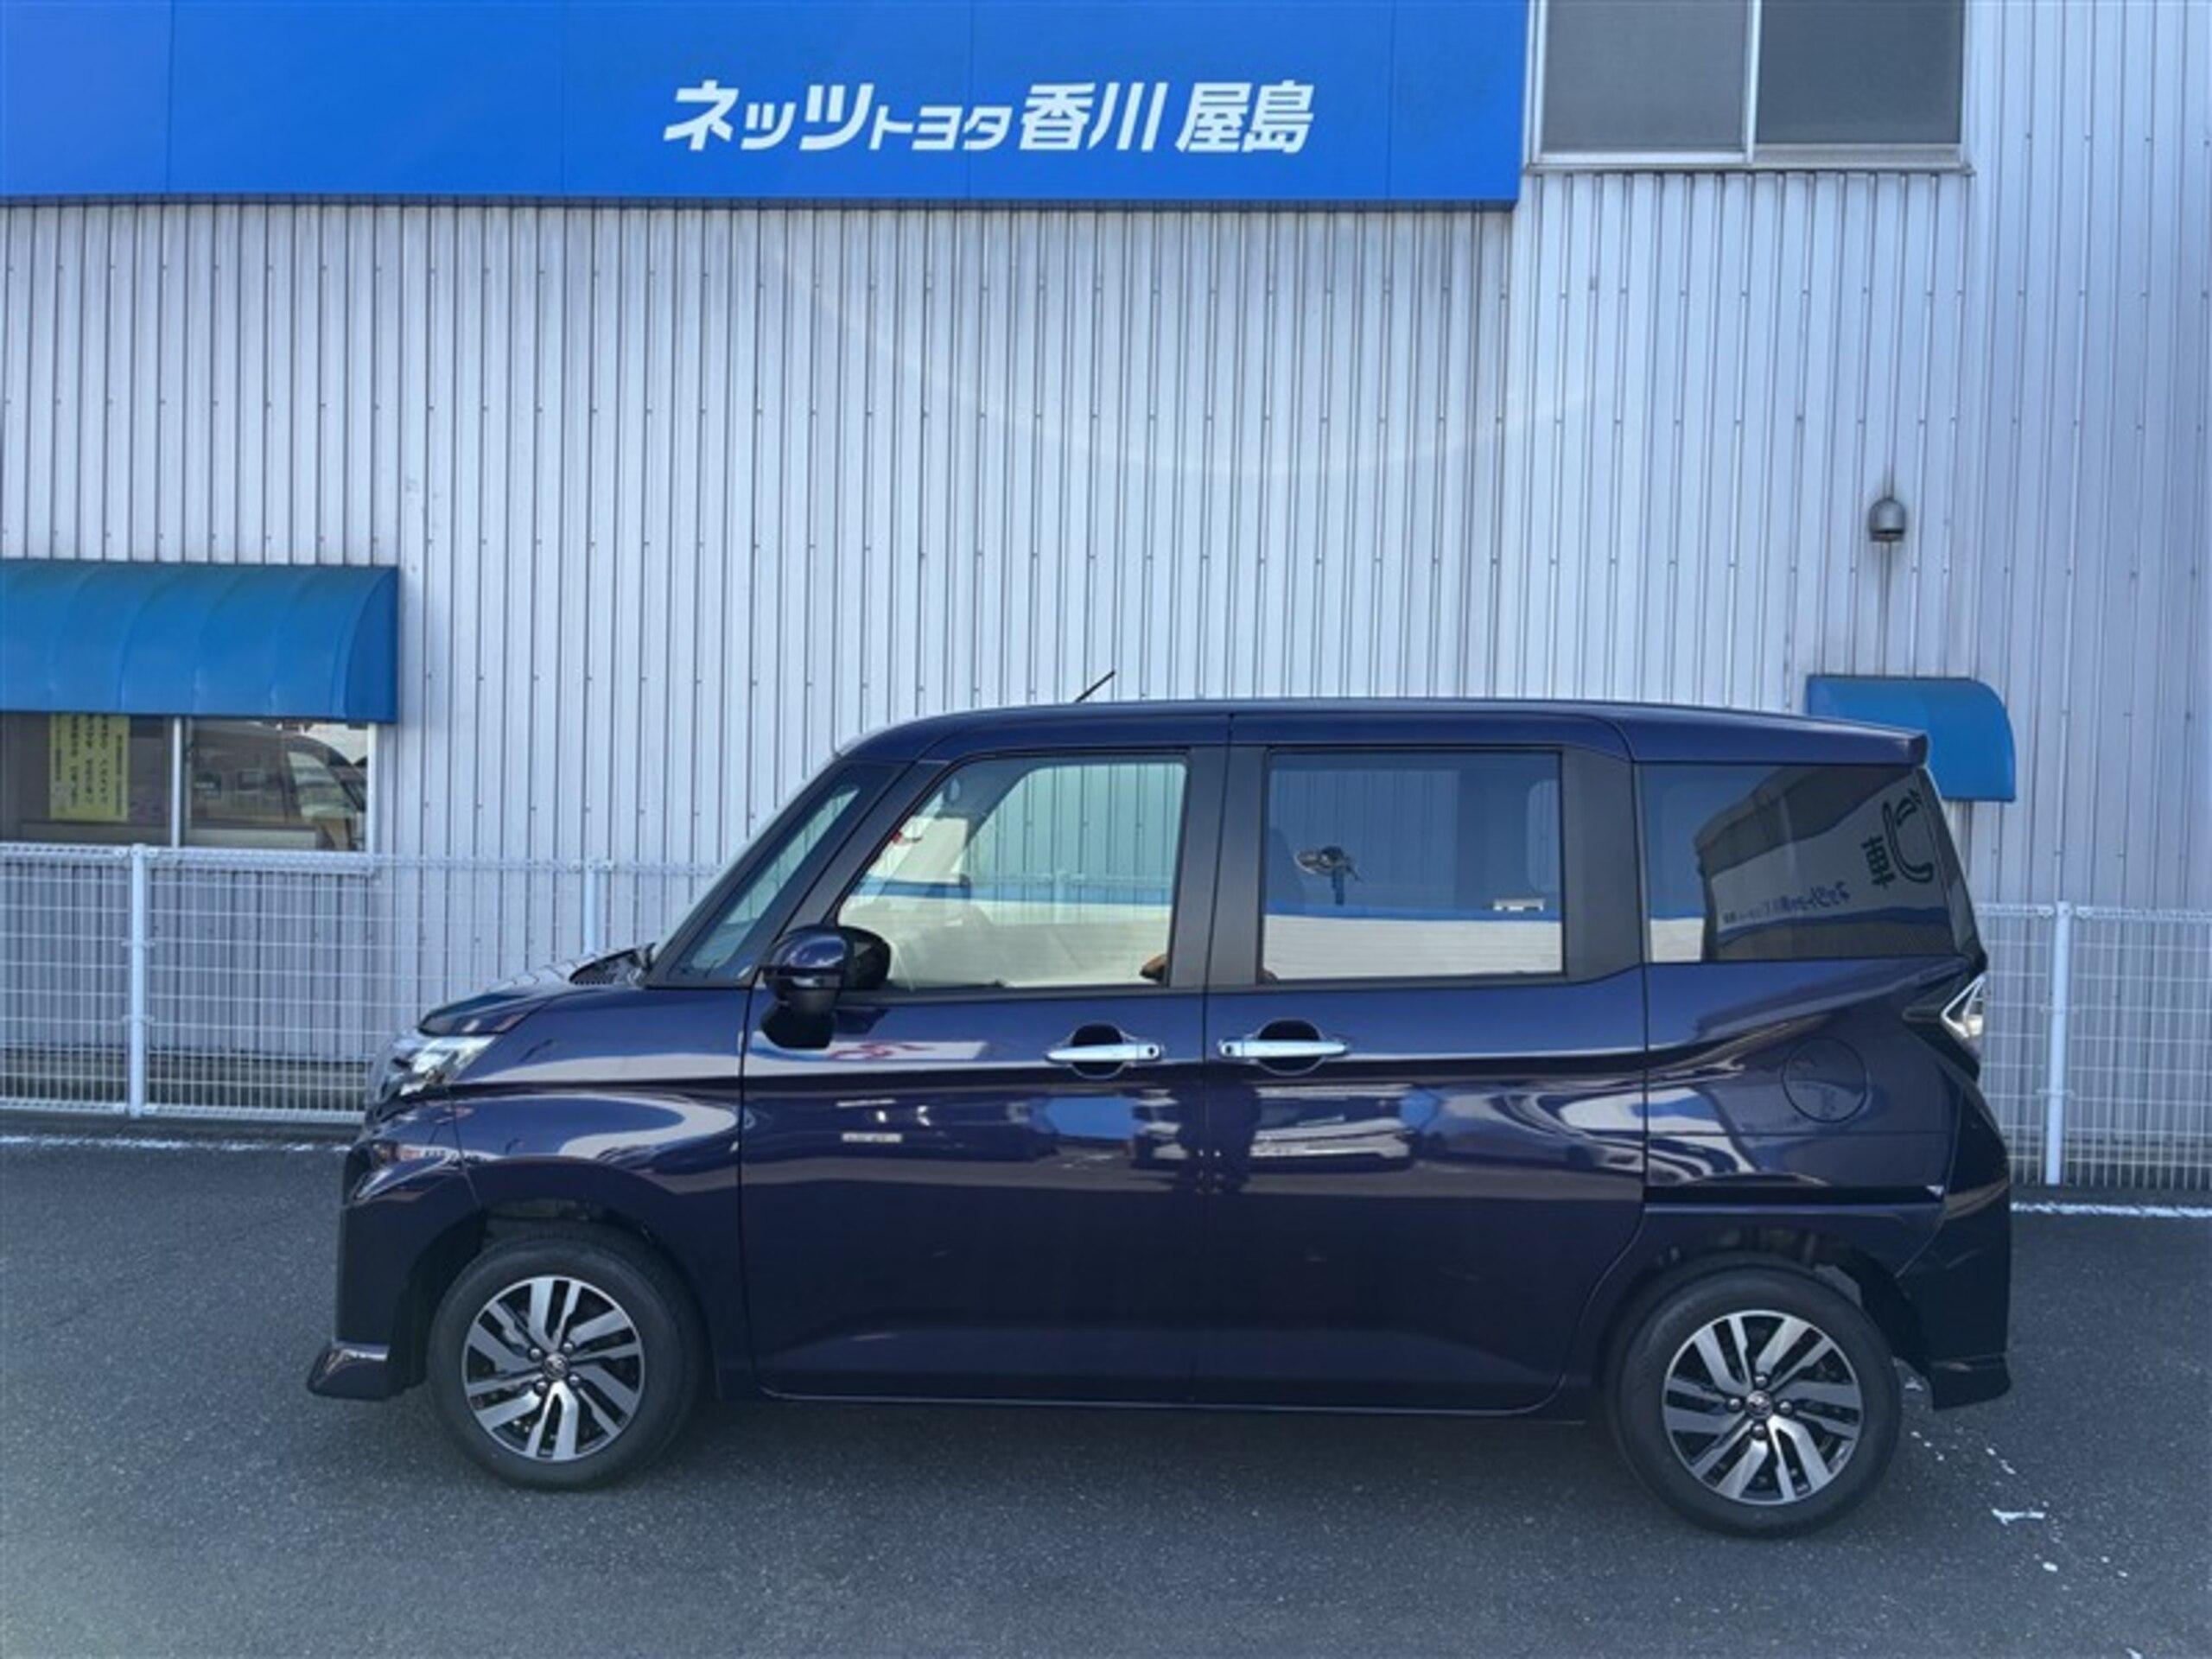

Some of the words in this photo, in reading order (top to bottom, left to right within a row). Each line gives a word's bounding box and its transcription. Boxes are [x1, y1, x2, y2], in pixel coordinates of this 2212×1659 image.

[664, 79, 1168, 152] ネッツトヨタ香川
[1175, 80, 1314, 154] 屋島
